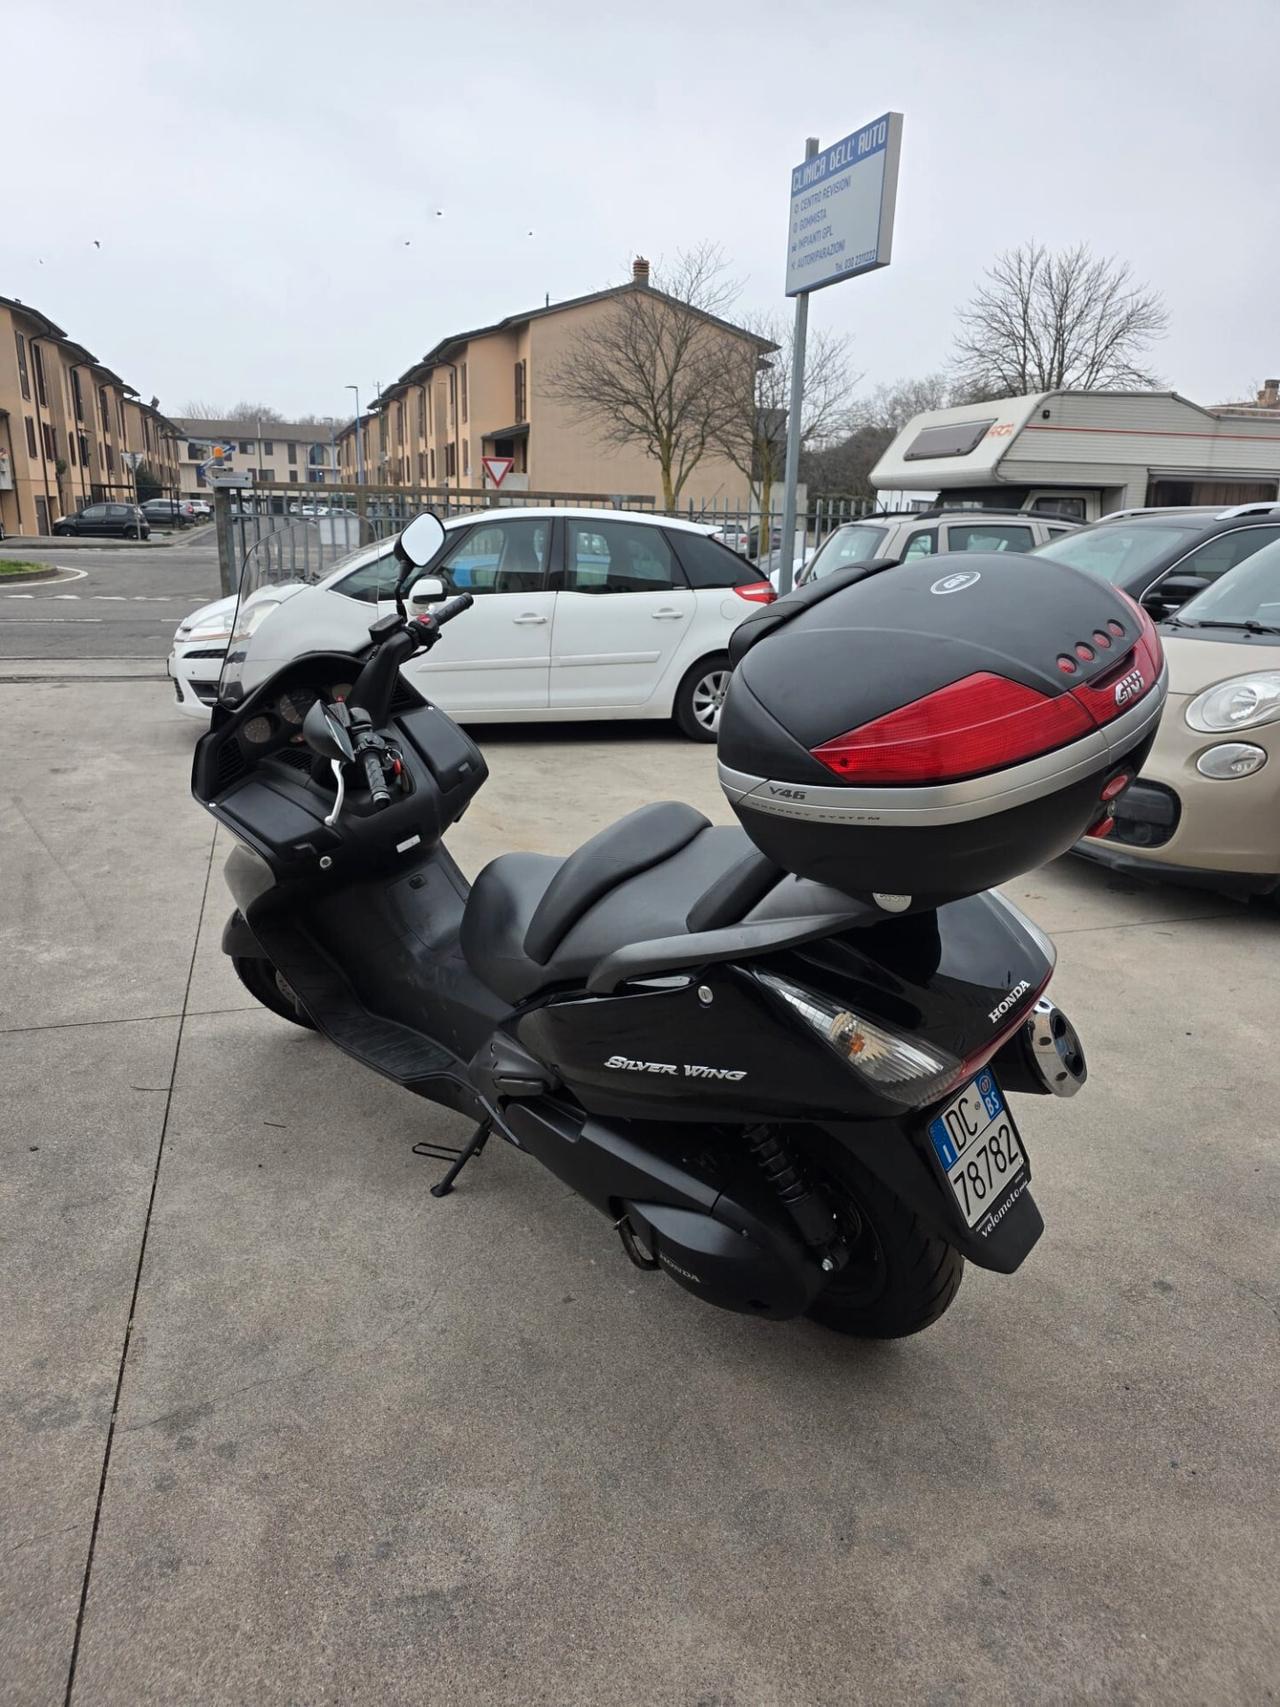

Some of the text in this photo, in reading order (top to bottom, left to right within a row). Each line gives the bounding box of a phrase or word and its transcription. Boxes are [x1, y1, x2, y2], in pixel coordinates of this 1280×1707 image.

[792, 156, 826, 192] CLINICA
[858, 121, 887, 155] AUTO
[800, 175, 851, 211] CENTRO REVISIONI
[798, 224, 834, 252] IMPIANTI GPL
[799, 209, 827, 231] GOMMISTA
[797, 240, 846, 269] AUTORIPARAZIONI
[1114, 670, 1145, 707] GIVI
[988, 980, 1031, 1024] HONDA
[604, 1055, 748, 1081] SILVER WING
[945, 1097, 978, 1152] DC
[985, 1091, 999, 1116] BS
[953, 1123, 1019, 1217] 78782
